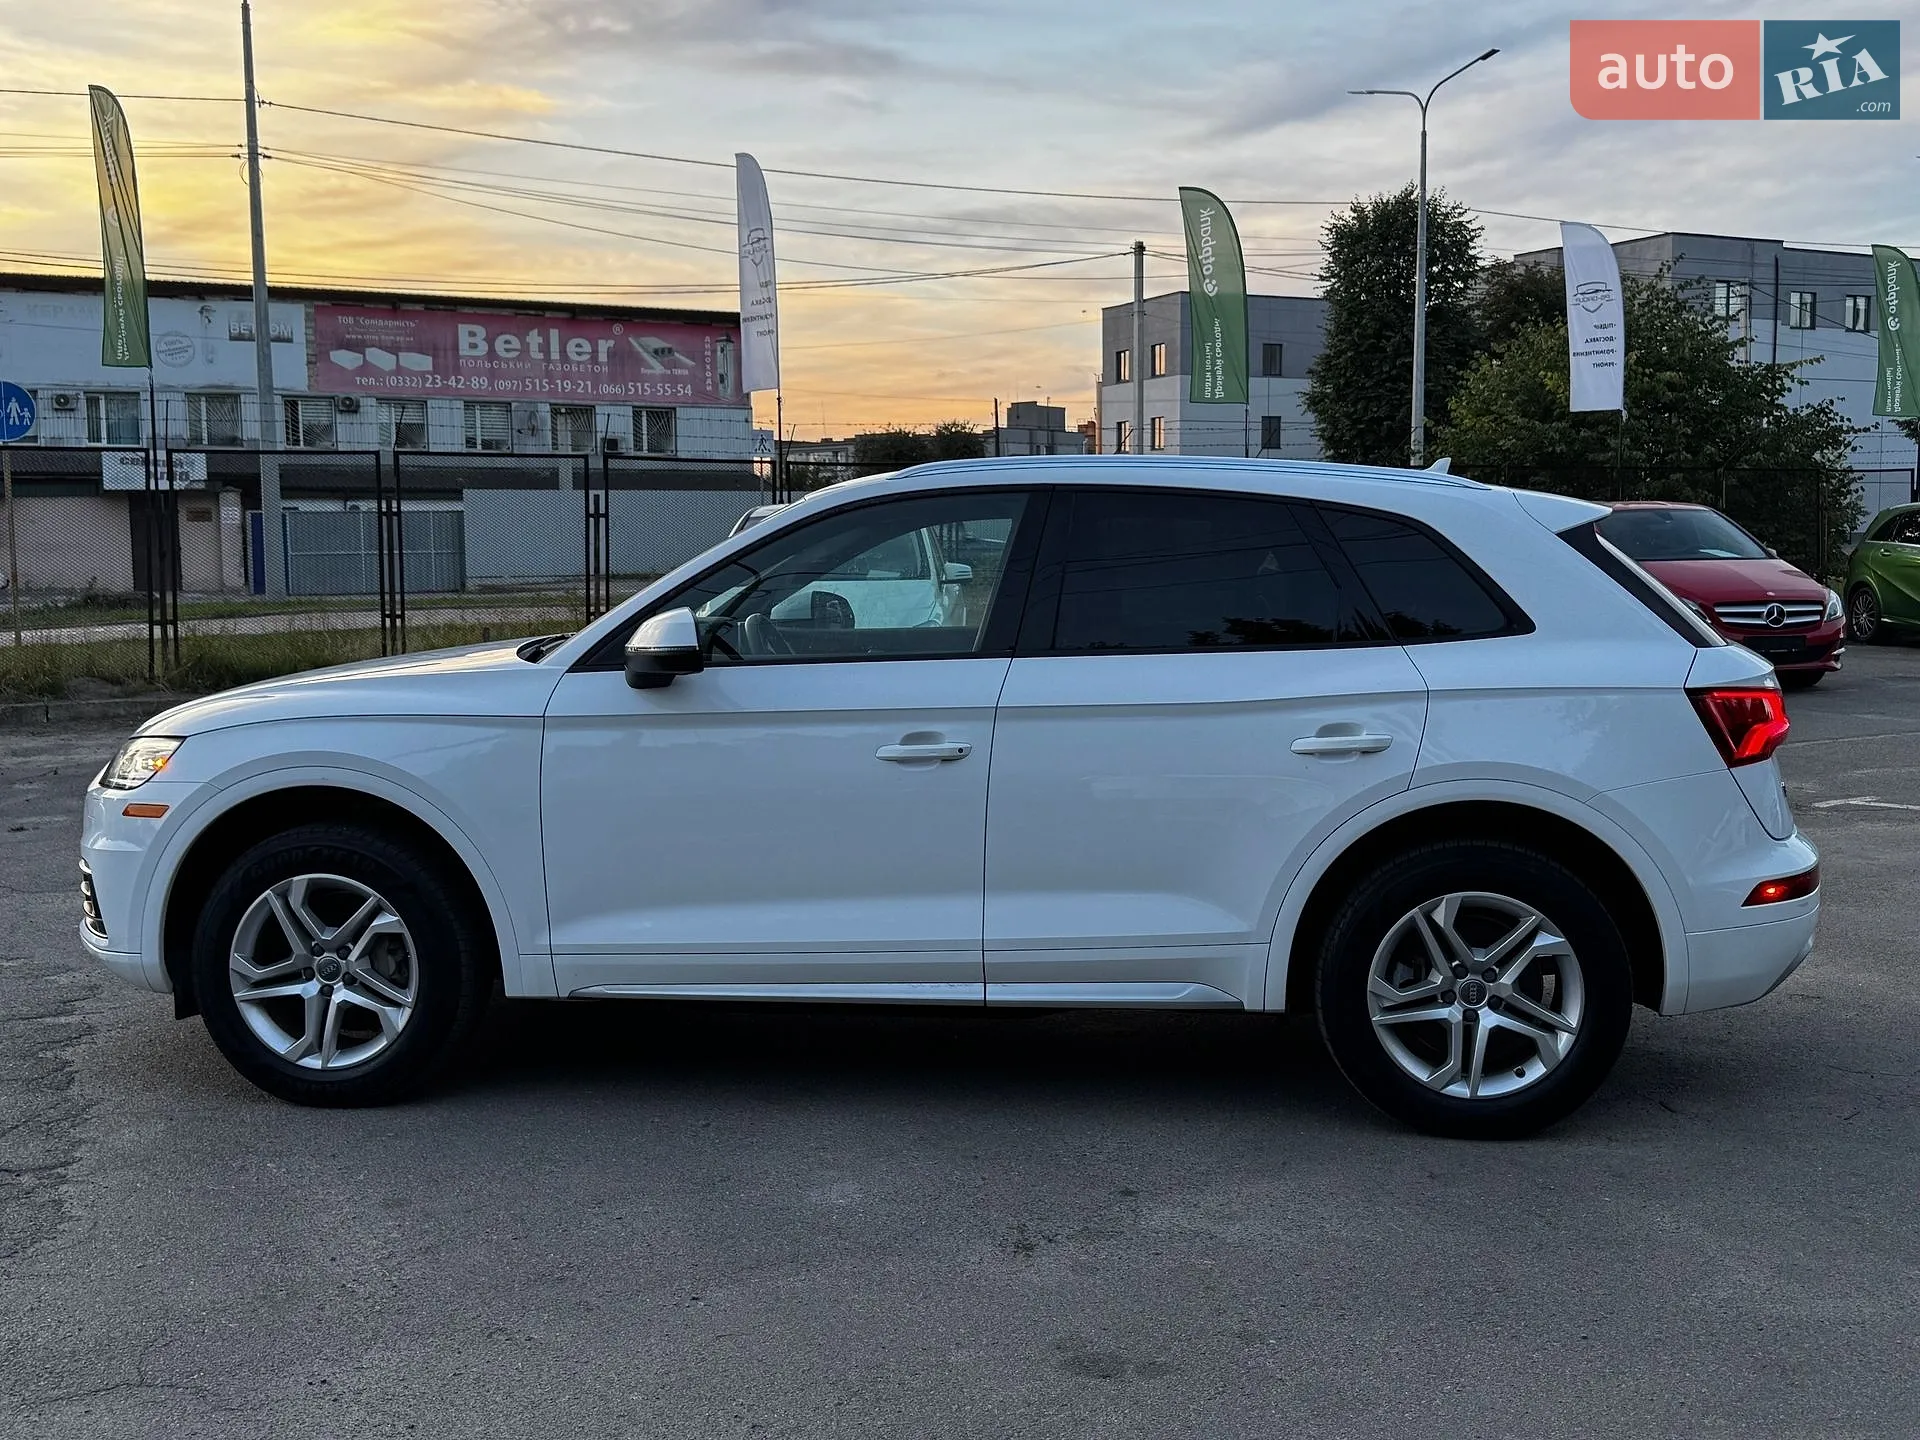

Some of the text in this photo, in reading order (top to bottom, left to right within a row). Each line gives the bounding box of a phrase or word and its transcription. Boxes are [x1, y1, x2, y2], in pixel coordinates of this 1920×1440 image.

[337, 315, 354, 325] ТОВ
[457, 323, 615, 363] Betler
[542, 362, 609, 373] ГАЗОБЕТОН
[355, 376, 384, 387] тел.:
[386, 375, 422, 389] (0332)
[494, 379, 523, 392] (097)
[599, 383, 625, 397] (066)
[628, 381, 693, 397] 515-55-54
